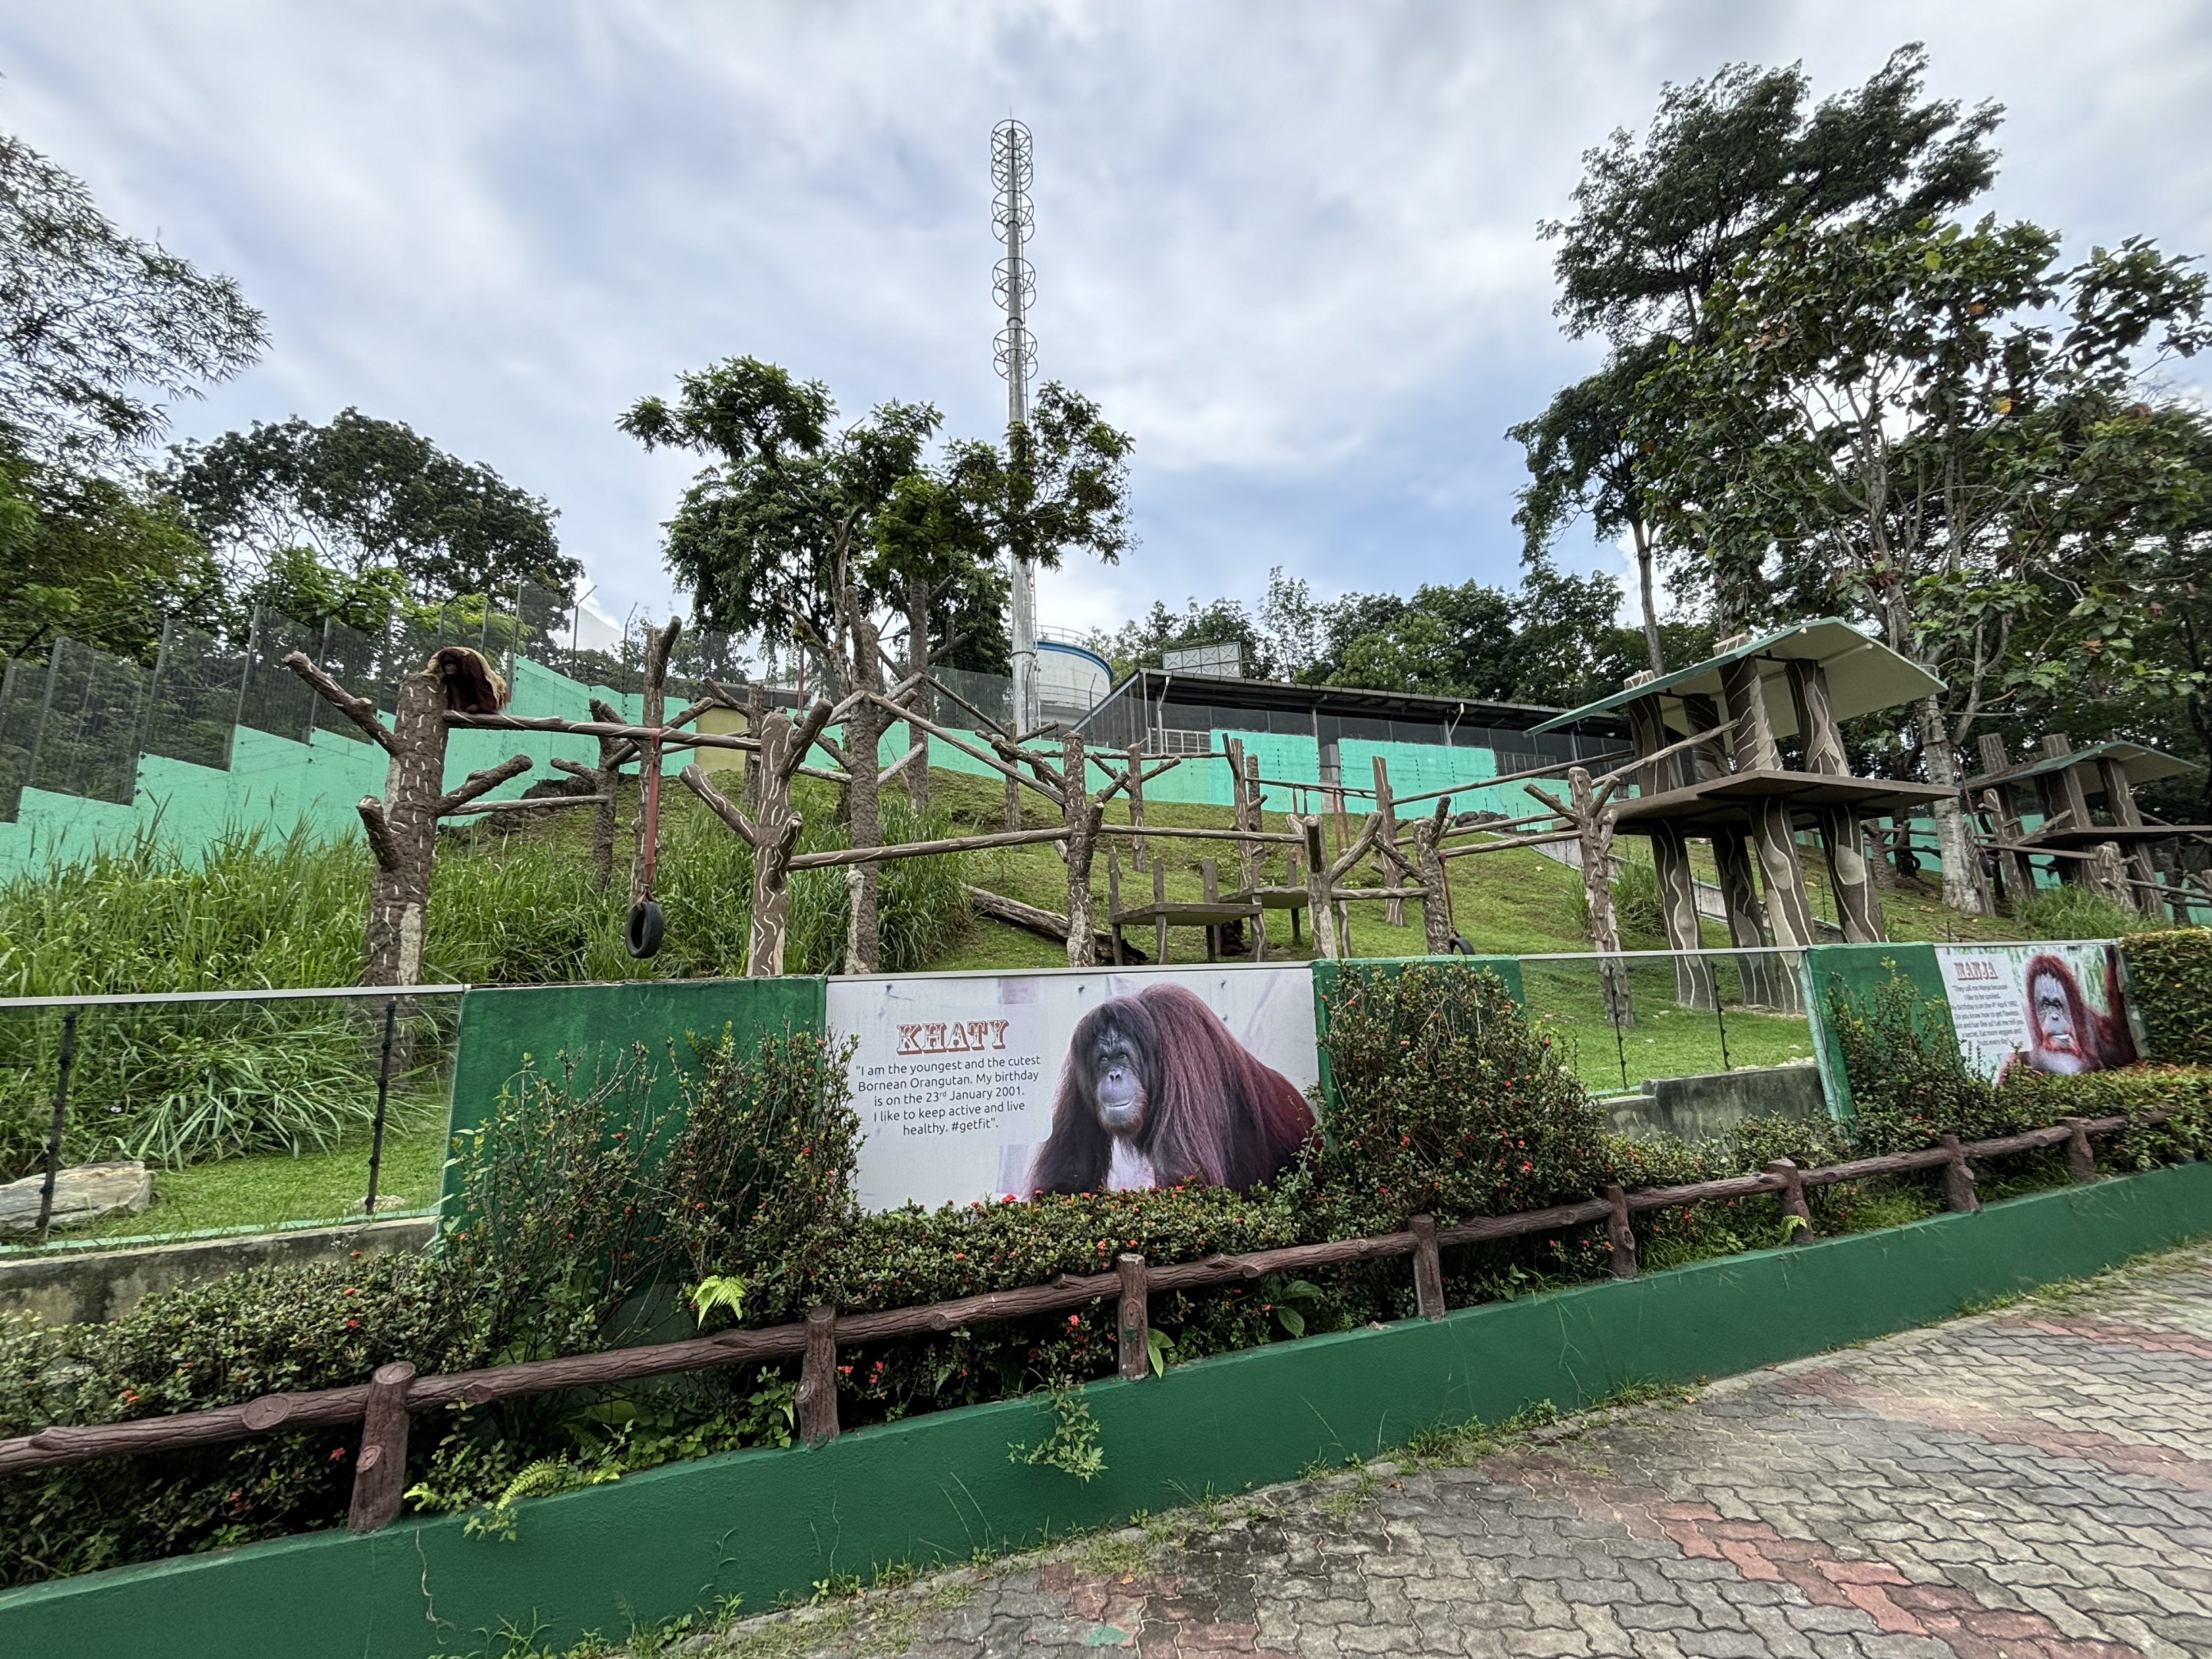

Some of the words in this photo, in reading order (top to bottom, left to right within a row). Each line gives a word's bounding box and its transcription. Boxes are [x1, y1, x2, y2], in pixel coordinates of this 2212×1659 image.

[1953, 962, 1998, 981] MANJA
[896, 1018, 1010, 1056] KHATY
[856, 1065, 864, 1076] "I
[867, 1067, 885, 1076] am
[888, 1063, 907, 1075] the
[910, 1060, 962, 1075] youngest
[965, 1058, 984, 1069] and
[988, 1057, 1005, 1068] the
[1008, 1055, 1041, 1067] cutest
[858, 1080, 907, 1091] Bornean
[910, 1075, 973, 1088] Orangutan.
[976, 1073, 992, 1085] My
[995, 1069, 1039, 1082] birthday
[874, 1095, 883, 1107] is
[886, 1097, 900, 1106] on
[904, 1093, 922, 1104] the
[926, 1091, 947, 1103] 23rd
[949, 1090, 993, 1101] January
[995, 1086, 1025, 1098] 2001.
[873, 1112, 876, 1122] I
[880, 1110, 900, 1122] like
[903, 1110, 916, 1121] to
[919, 1108, 946, 1120] keep
[949, 1104, 982, 1117] active
[984, 1101, 1004, 1114] and
[1007, 1101, 1025, 1111] live
[903, 1122, 949, 1136] healthy.
[951, 1117, 998, 1134] #getfit".
